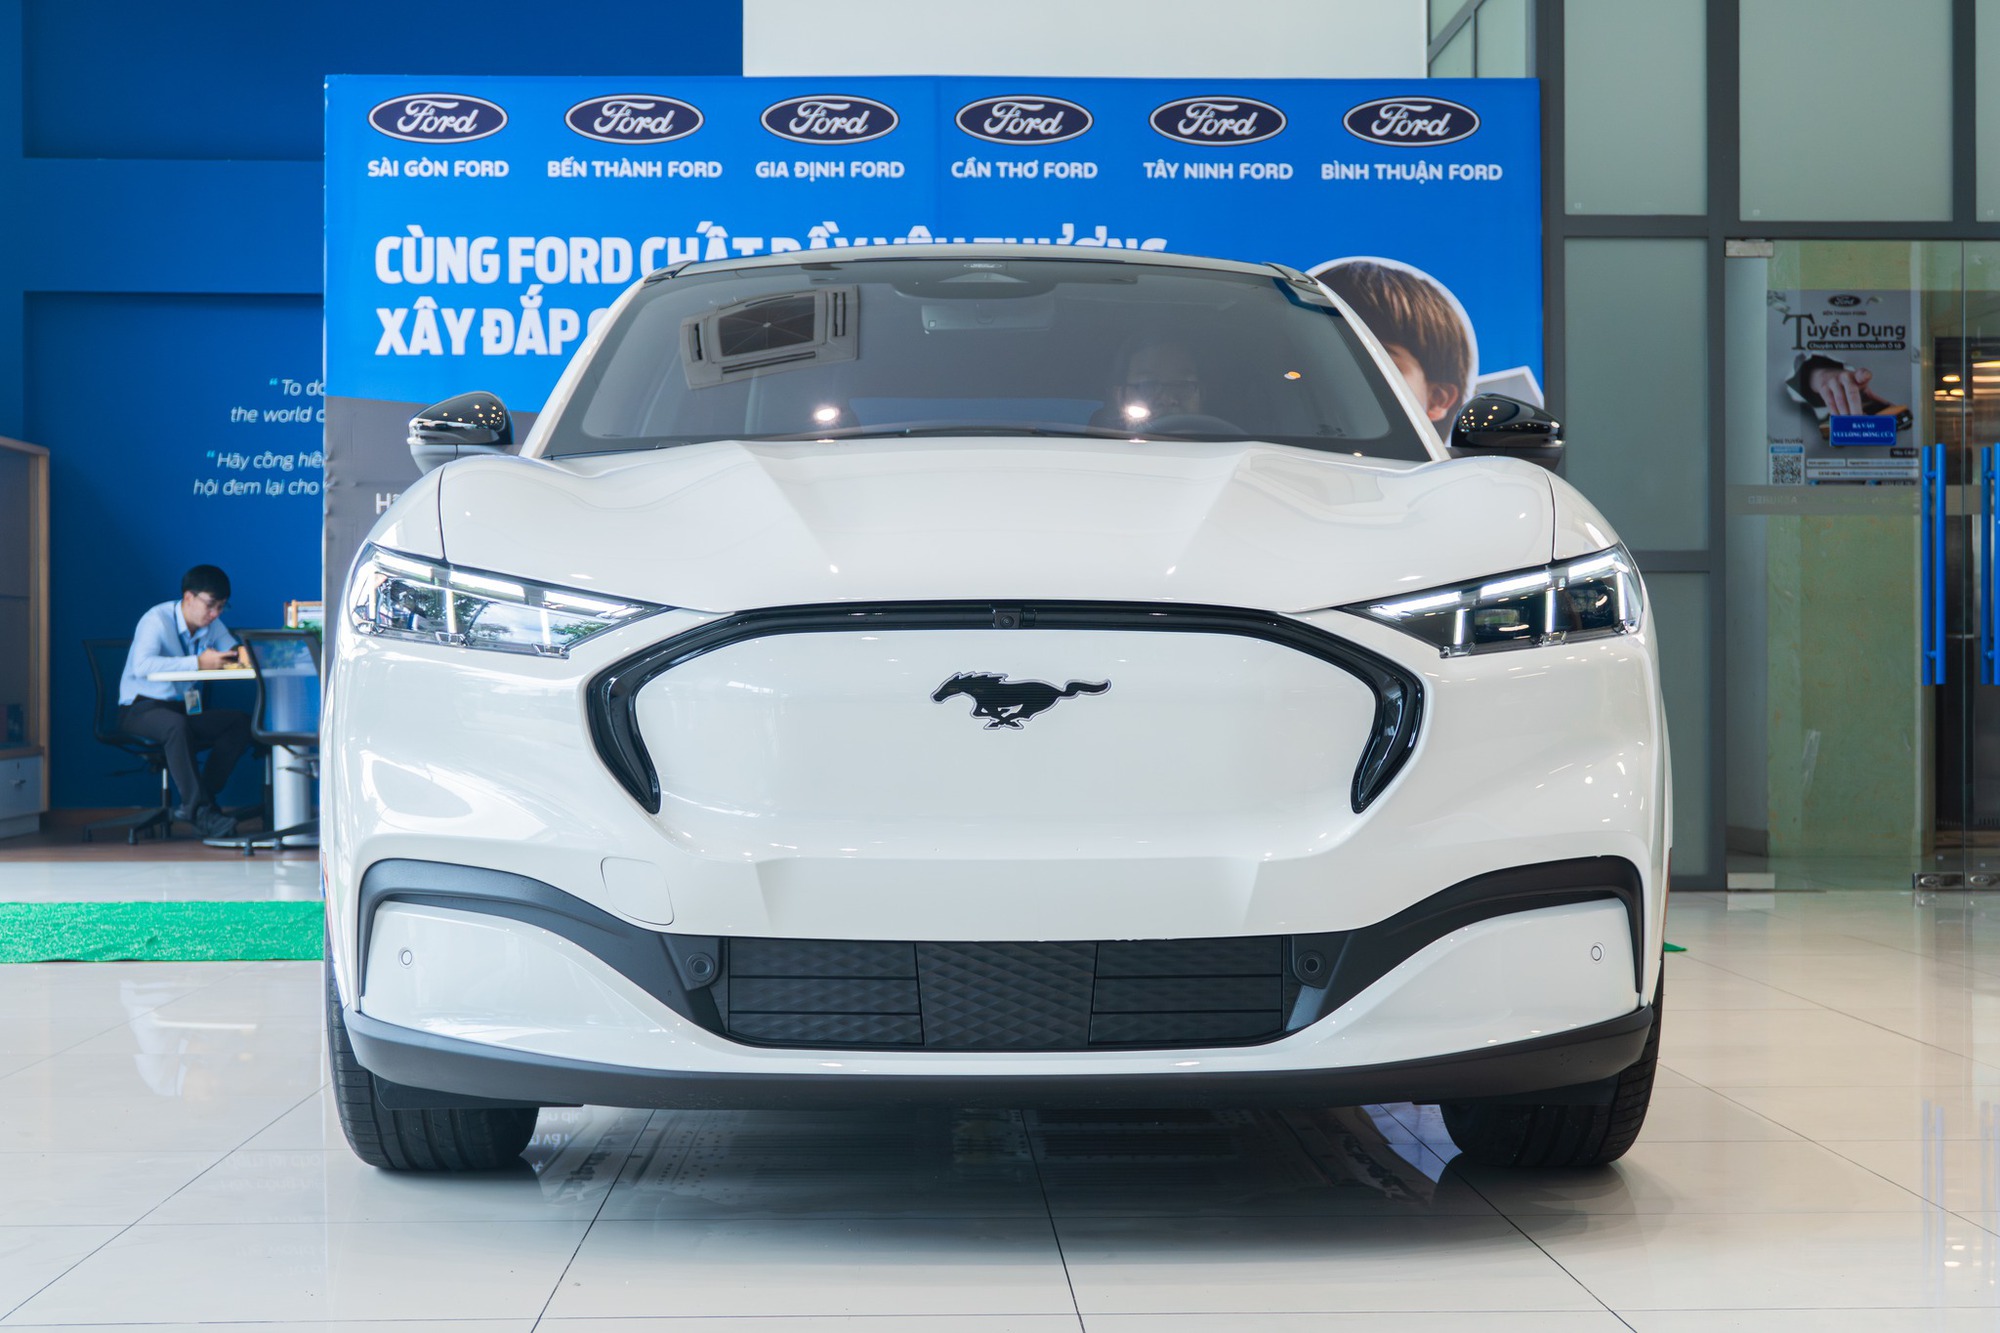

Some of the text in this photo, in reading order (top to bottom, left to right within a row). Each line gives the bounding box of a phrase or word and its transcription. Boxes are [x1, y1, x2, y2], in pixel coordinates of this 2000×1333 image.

[396, 98, 479, 134] Ford
[593, 99, 675, 135] Ford
[788, 101, 869, 136] Ford
[983, 101, 1064, 136] Ford
[1177, 102, 1257, 137] Ford
[1370, 102, 1451, 137] Ford
[367, 157, 509, 178] SÀI GÒN FORD
[547, 156, 723, 179] BẾN THÀNH FORD
[755, 161, 906, 183] GIA ĐỊNH FORD
[951, 157, 1098, 180] CẦN THƠ FORD
[1143, 159, 1294, 180] TÂY NINH FORD
[1321, 160, 1503, 185] BÌNH THUẬN FORD
[375, 224, 501, 284] CÙNG
[508, 236, 634, 285] FORD
[375, 296, 477, 356] XÂY
[480, 283, 580, 356] ĐẮP
[1857, 322, 1906, 342] Dụng
[231, 406, 259, 423] the
[263, 406, 313, 424] world
[288, 478, 320, 496] cho
